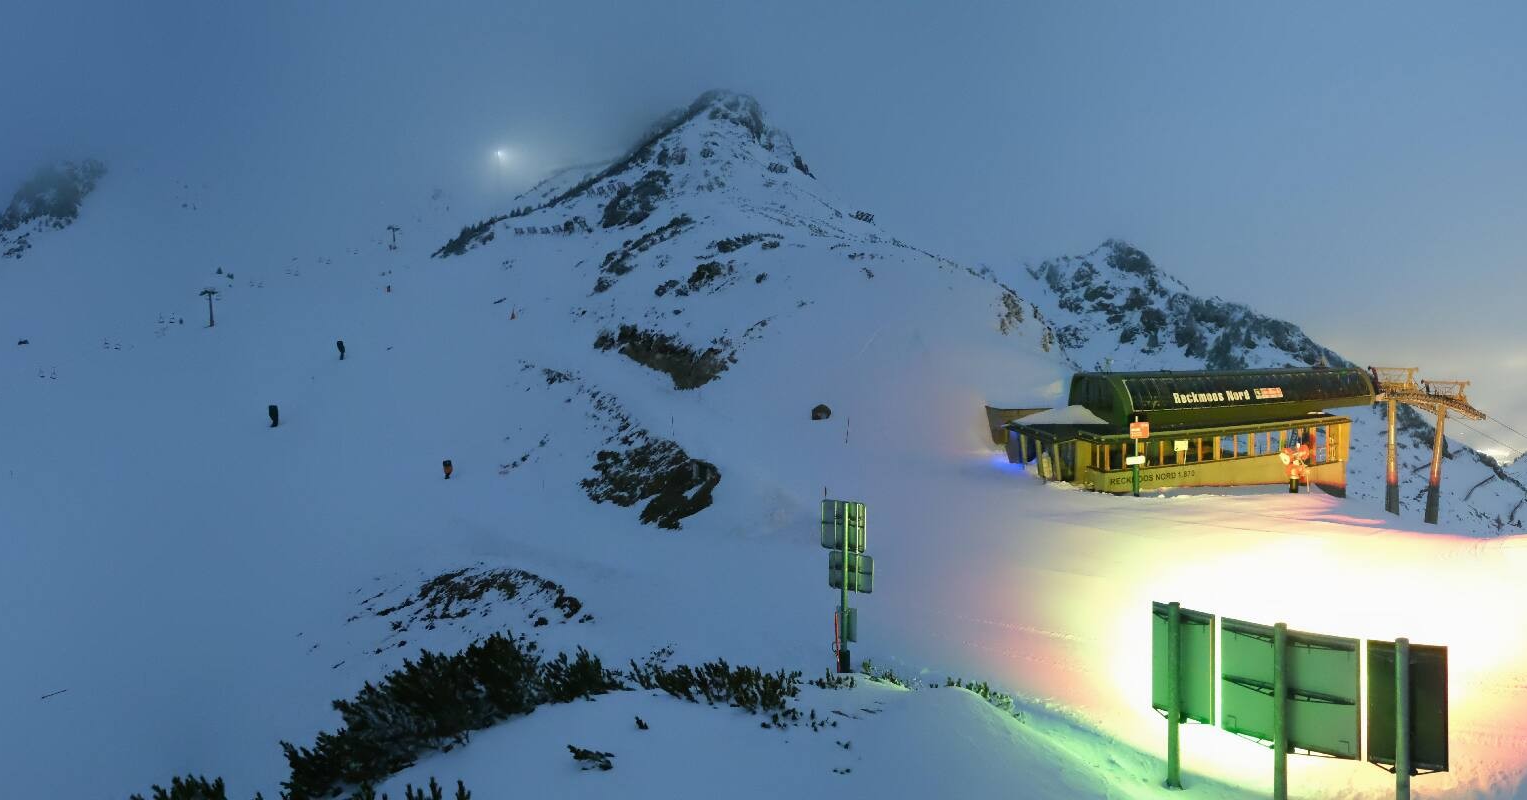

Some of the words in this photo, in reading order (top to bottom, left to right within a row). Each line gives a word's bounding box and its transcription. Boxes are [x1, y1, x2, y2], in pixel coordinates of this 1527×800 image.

[1173, 391, 1224, 404] Reckmoos
[1226, 389, 1250, 402] Nord
[1110, 474, 1154, 485] RECKOOS
[1155, 472, 1176, 481] NORD
